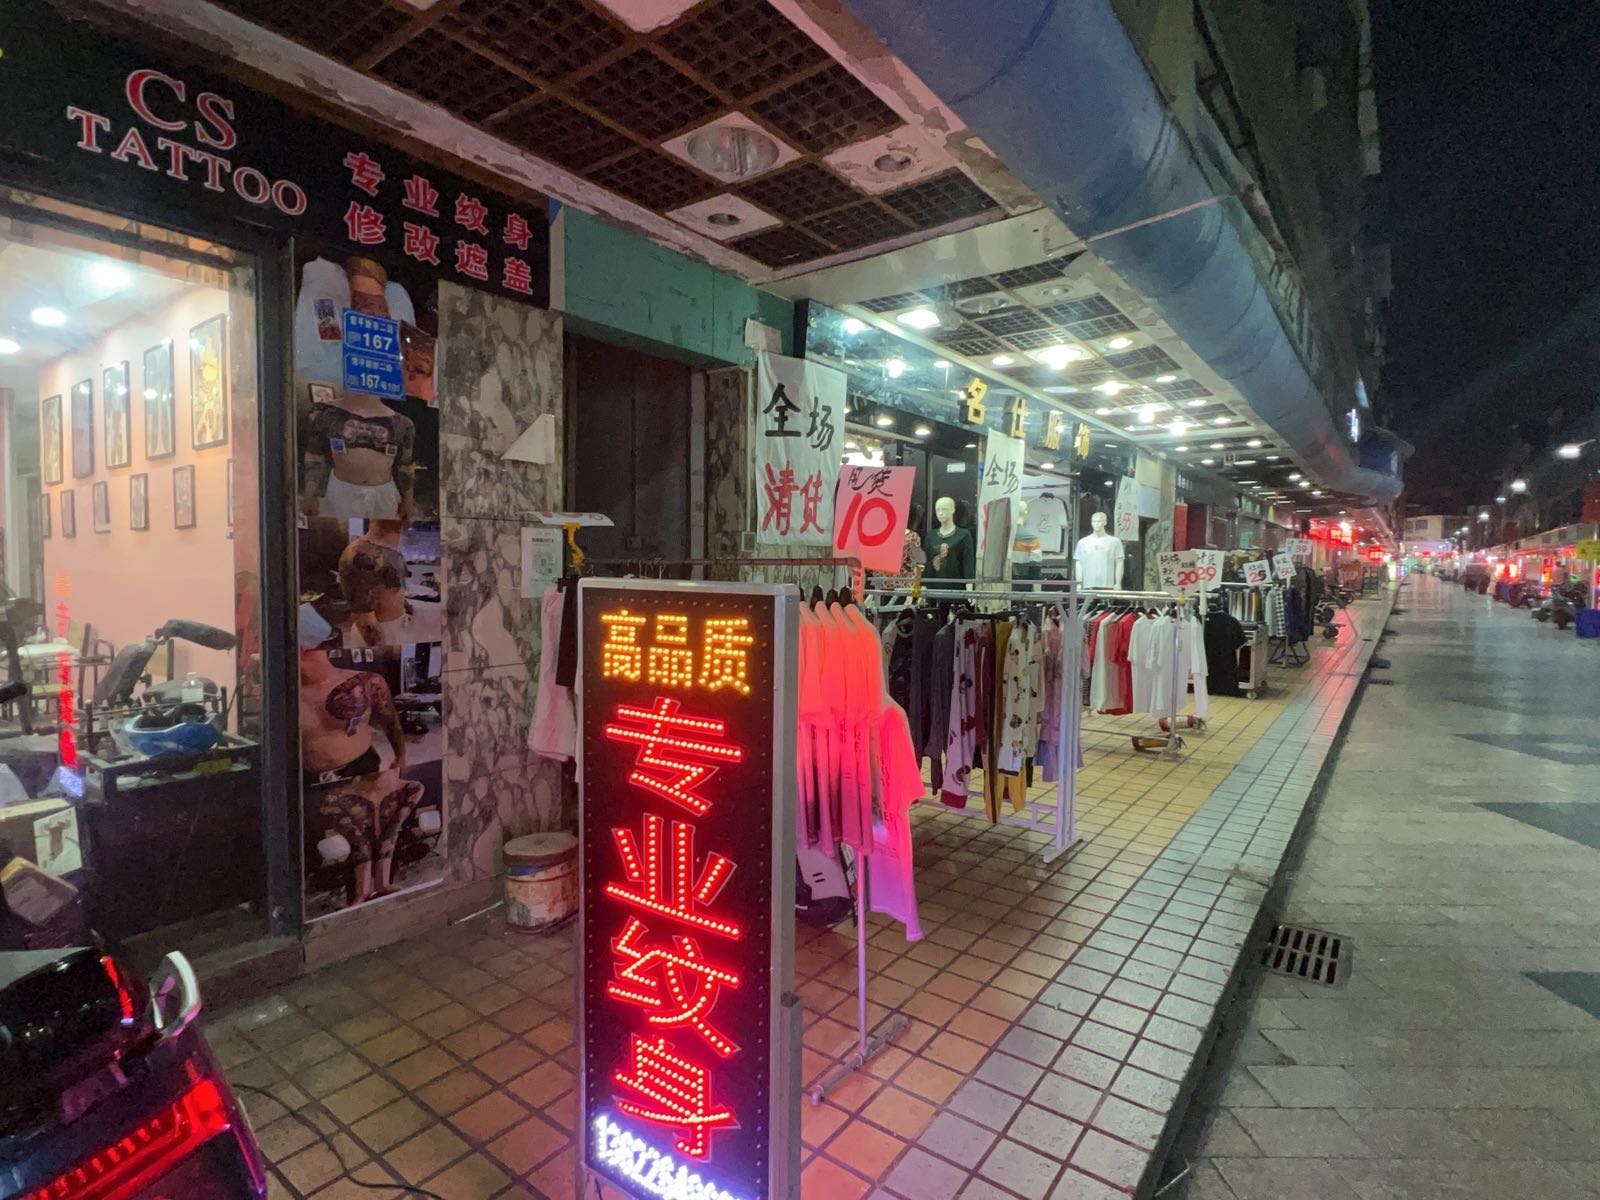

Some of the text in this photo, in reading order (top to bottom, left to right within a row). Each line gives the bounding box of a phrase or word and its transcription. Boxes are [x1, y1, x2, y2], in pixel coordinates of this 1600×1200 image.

[126, 69, 237, 150] CS
[67, 105, 308, 216] TATTOO
[343, 151, 533, 251] 专业纹身
[344, 200, 534, 296] 修改遮盖
[362, 333, 393, 351] 167
[762, 382, 836, 452] 全场
[762, 460, 826, 537] 清货
[985, 454, 1020, 496] 全场
[837, 492, 897, 550] 10
[601, 609, 754, 695] 高品质
[605, 696, 742, 1163] 专业纹身
